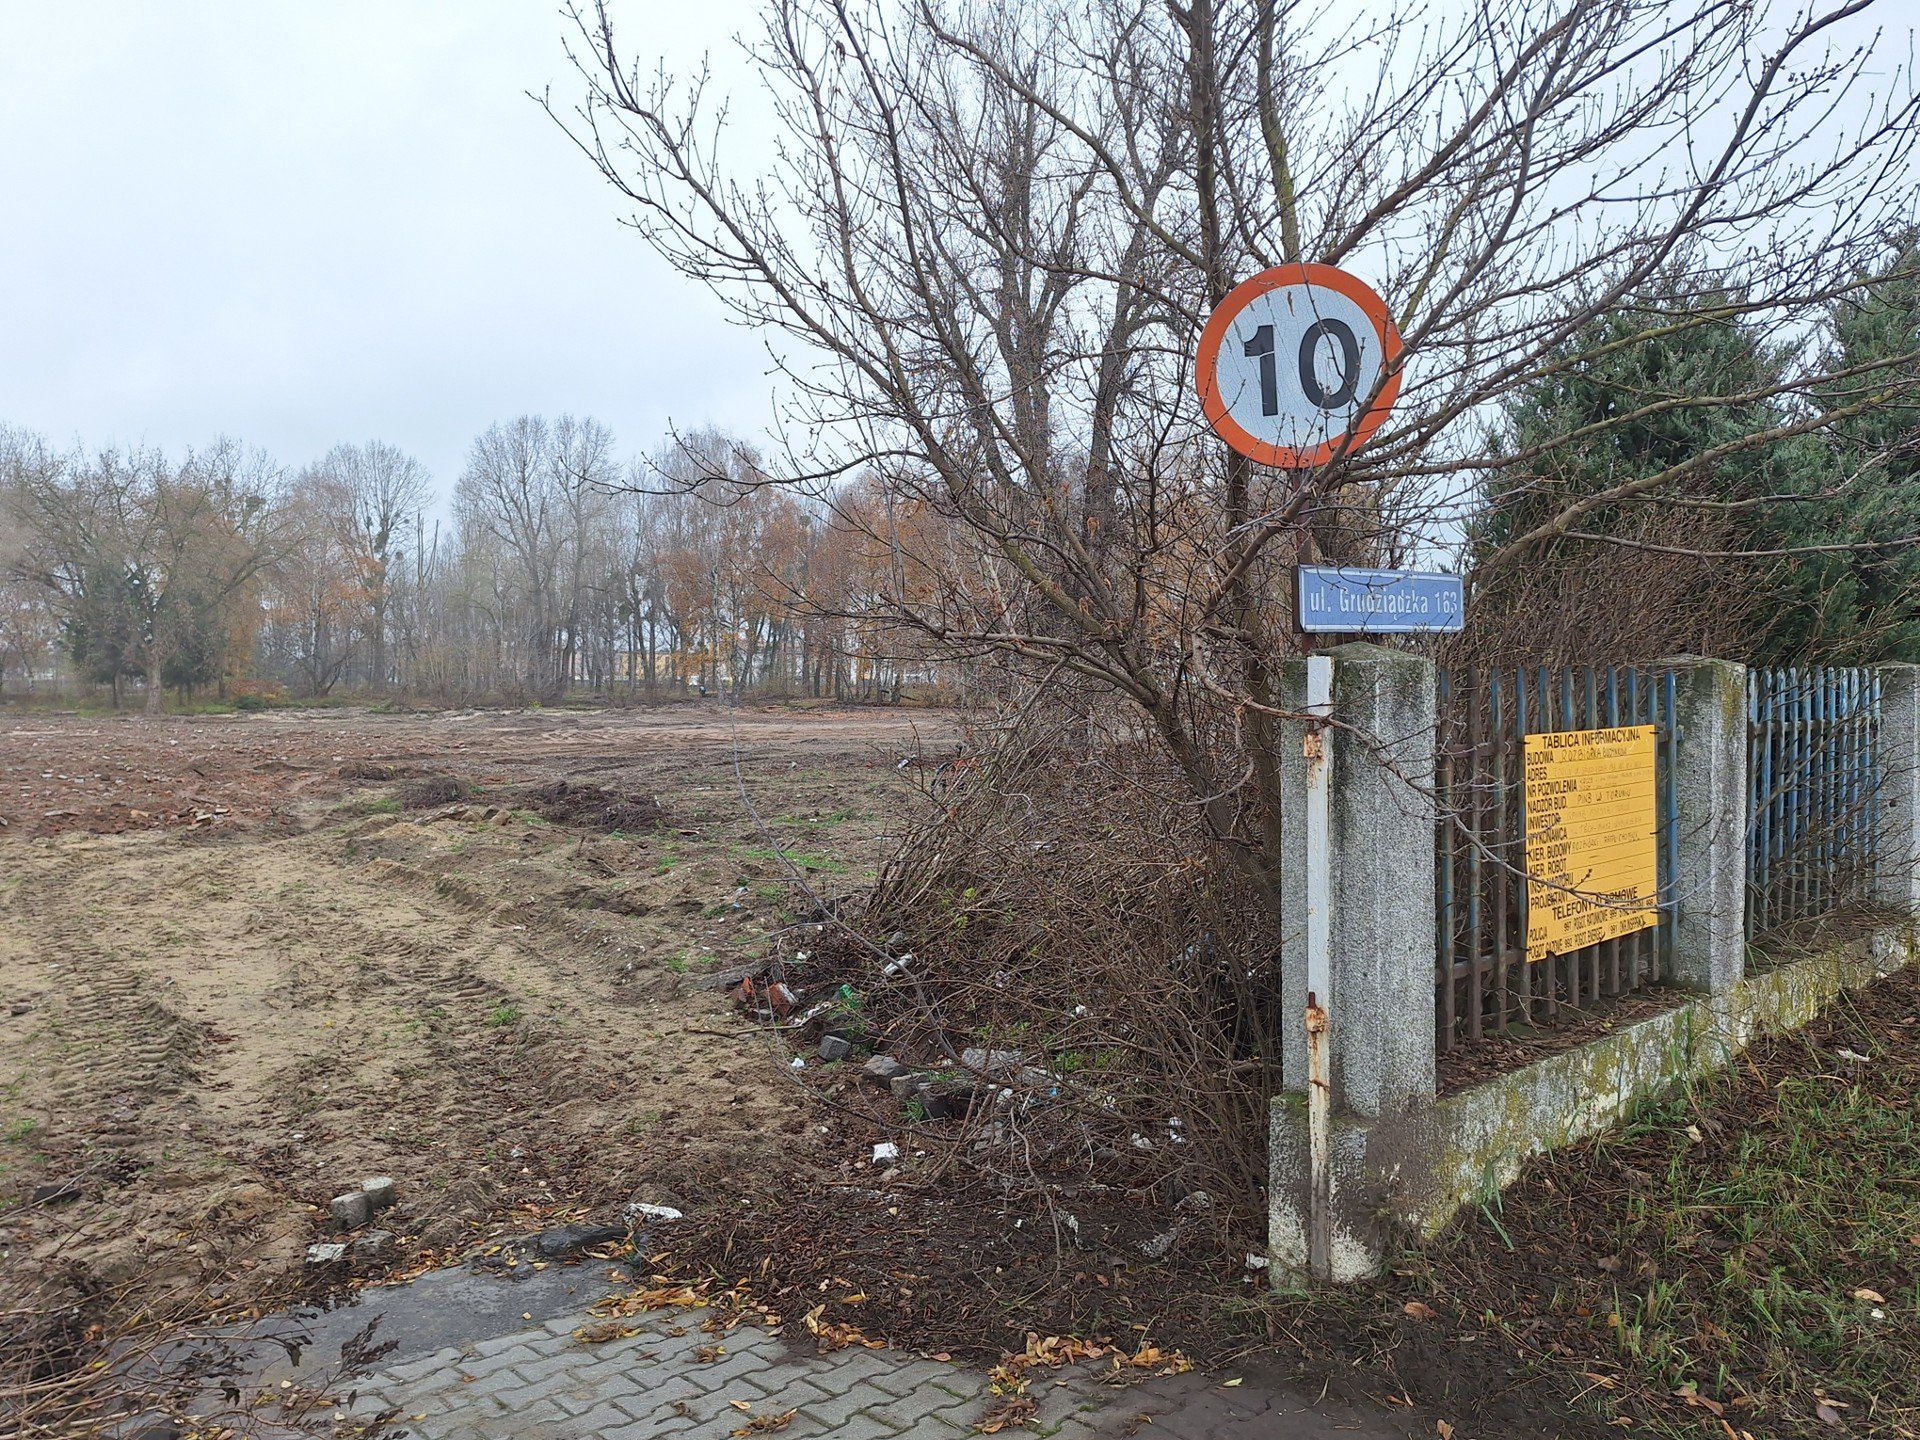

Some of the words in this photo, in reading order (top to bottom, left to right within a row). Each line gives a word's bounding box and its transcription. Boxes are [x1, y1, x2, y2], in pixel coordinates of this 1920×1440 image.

[1244, 318, 1359, 417] 10
[1310, 586, 1332, 612] ul.
[1340, 587, 1428, 621] Grudziądzka
[1434, 591, 1458, 614] 163
[1542, 733, 1580, 750] TABLICA
[1581, 728, 1641, 747] INFORMACYJNA
[1527, 750, 1554, 766] BUDOWA
[1527, 766, 1547, 781] ADRES
[1527, 784, 1536, 799] NR
[1537, 779, 1577, 797] POZWOLENIA
[1528, 826, 1568, 847] WYKONAWCA
[1547, 841, 1571, 859] BUDOWY
[1548, 858, 1566, 874] ROBOT
[1552, 896, 1593, 921] TELEFONY
[1529, 927, 1548, 942] POLICJA
